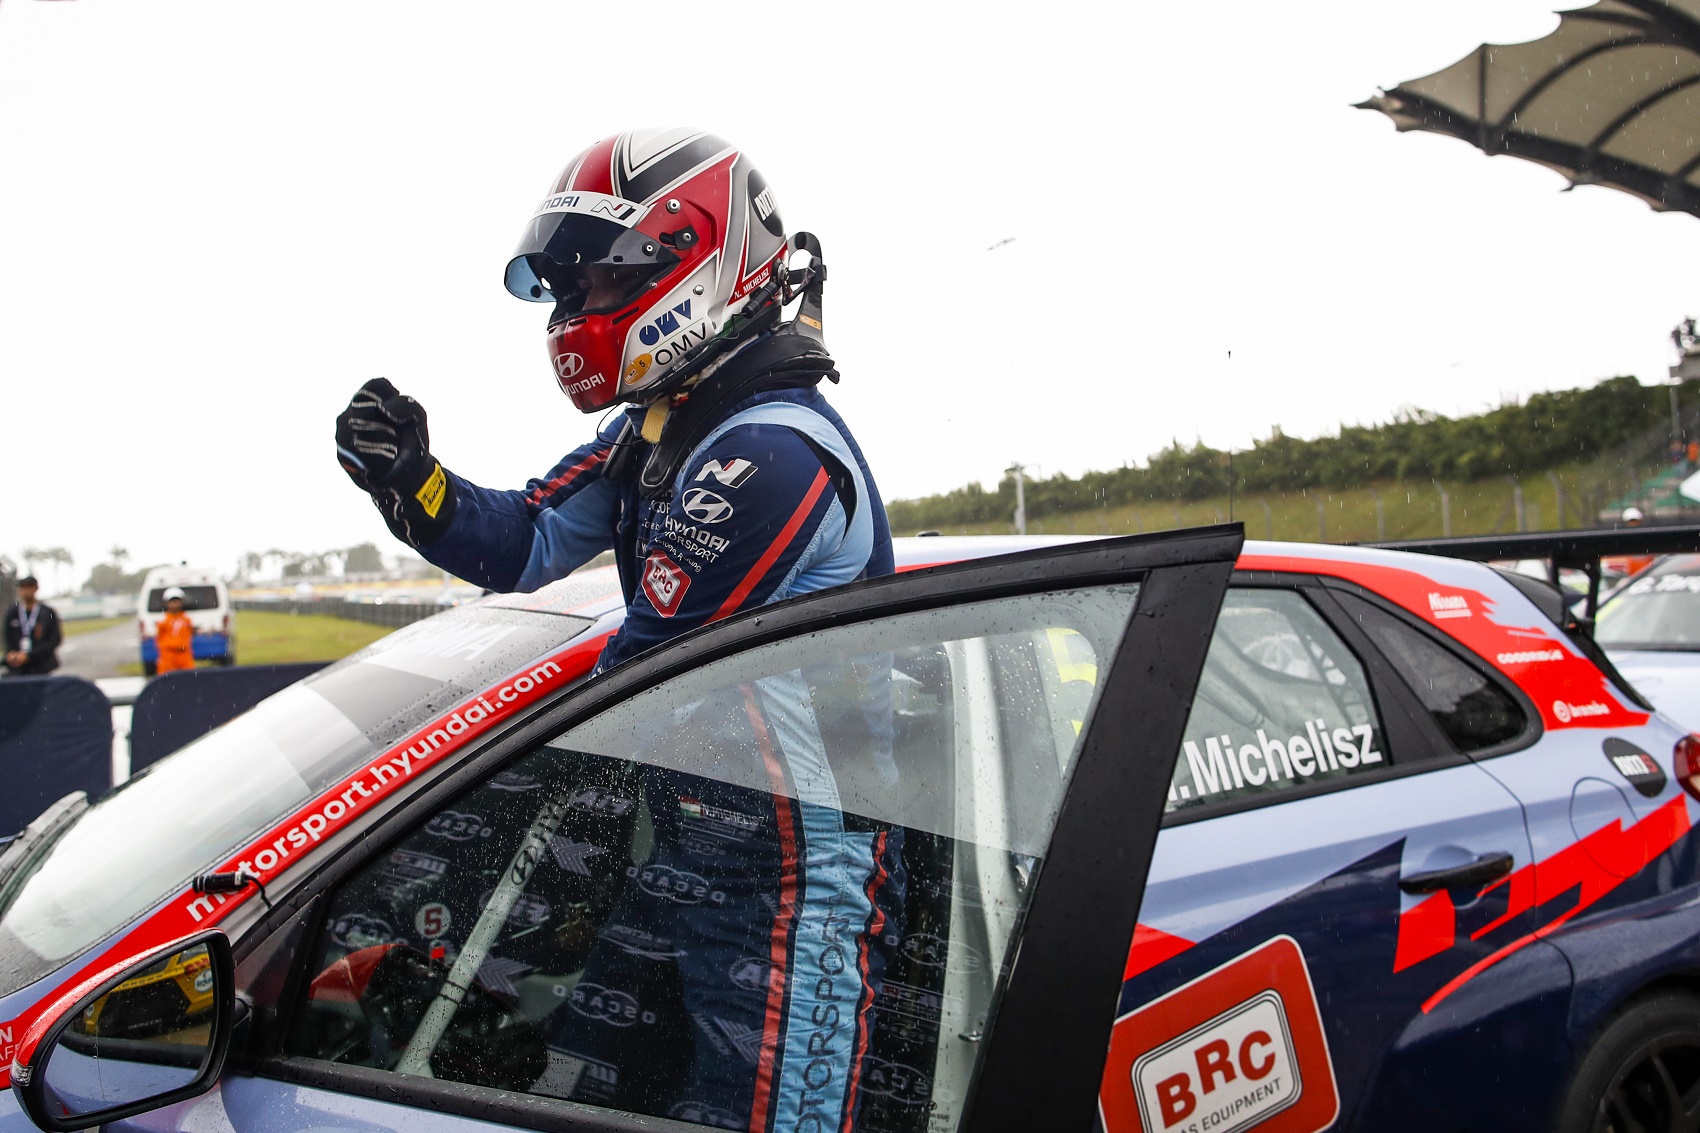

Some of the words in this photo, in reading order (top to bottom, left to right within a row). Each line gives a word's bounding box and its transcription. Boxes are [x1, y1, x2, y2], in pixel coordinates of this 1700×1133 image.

[743, 267, 770, 293] MICHELISZ
[655, 322, 706, 366] OMV
[638, 360, 646, 368] 5
[653, 565, 674, 595] BRC
[1168, 718, 1382, 801] .Michelisz
[424, 907, 443, 936] 5
[1156, 1030, 1276, 1129] BRC
[1202, 1077, 1281, 1130] EQUIPMENT
